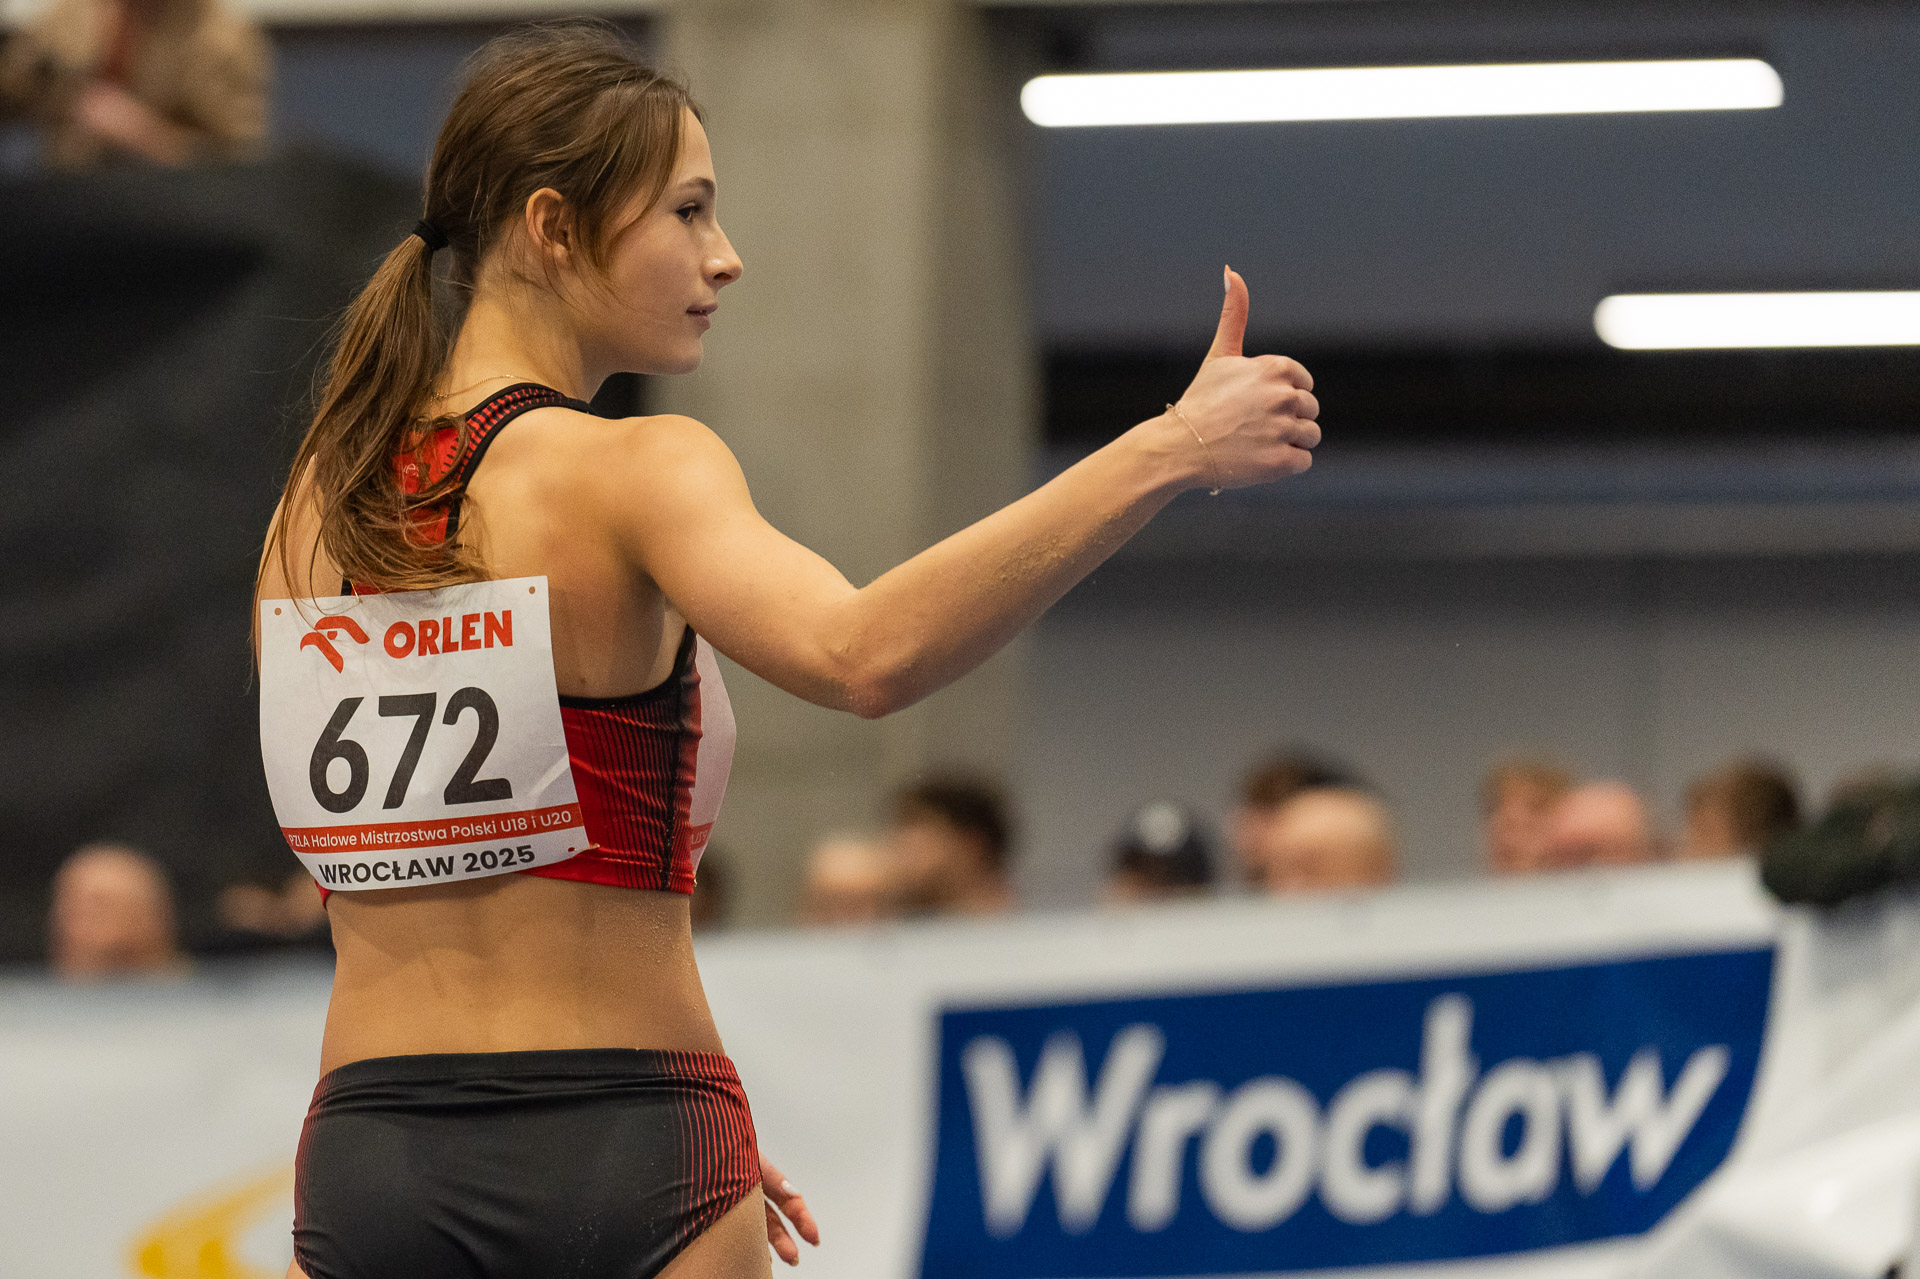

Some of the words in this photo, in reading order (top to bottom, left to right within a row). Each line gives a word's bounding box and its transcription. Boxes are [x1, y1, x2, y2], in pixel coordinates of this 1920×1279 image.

[383, 610, 513, 659] ORLEN
[309, 686, 513, 813] 672
[288, 834, 310, 848] PZLA
[311, 833, 357, 848] Halowe
[360, 827, 447, 845] Mistrzostwa
[451, 820, 497, 838] Polski
[500, 817, 528, 832] U18
[531, 815, 537, 829] i
[540, 810, 572, 827] U20
[318, 855, 454, 884] WROCŁAW
[462, 844, 536, 873] 2025
[961, 993, 1731, 1235] Wrocław
